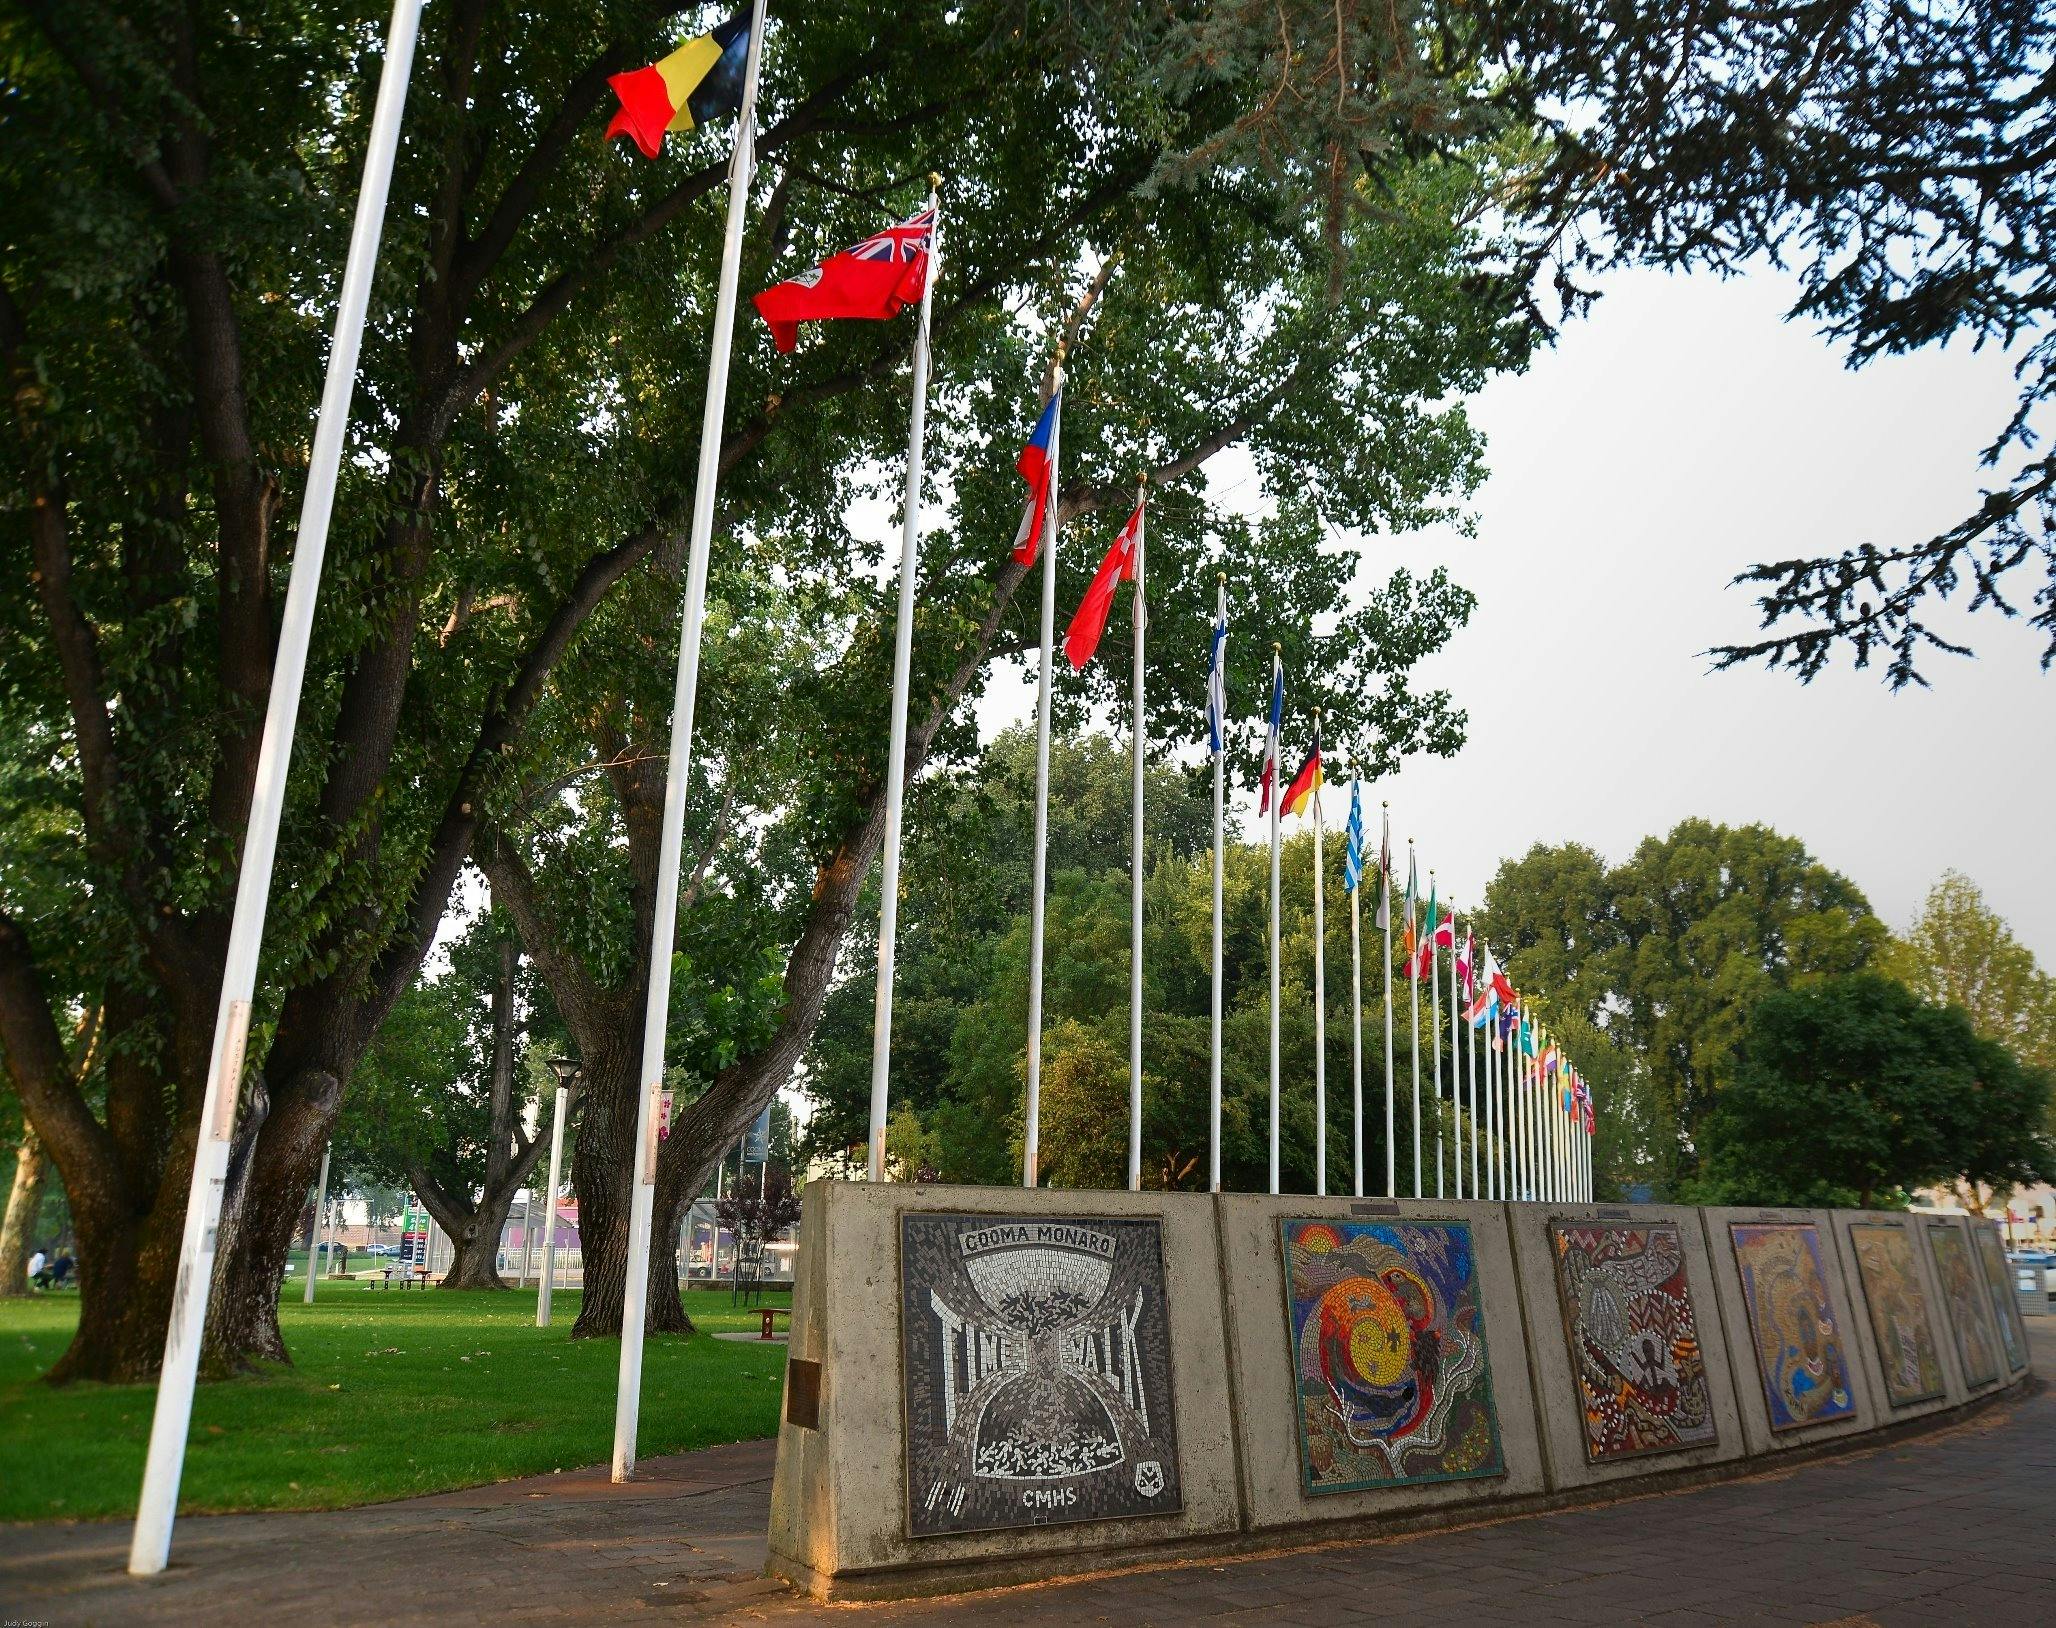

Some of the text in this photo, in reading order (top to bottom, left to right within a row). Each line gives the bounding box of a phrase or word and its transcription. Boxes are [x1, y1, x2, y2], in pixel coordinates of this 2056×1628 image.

[228, 1038, 242, 1104] AUSTRALIA
[965, 1226, 1110, 1253] COOMA MONARO
[1022, 1487, 1077, 1509] CMHS
